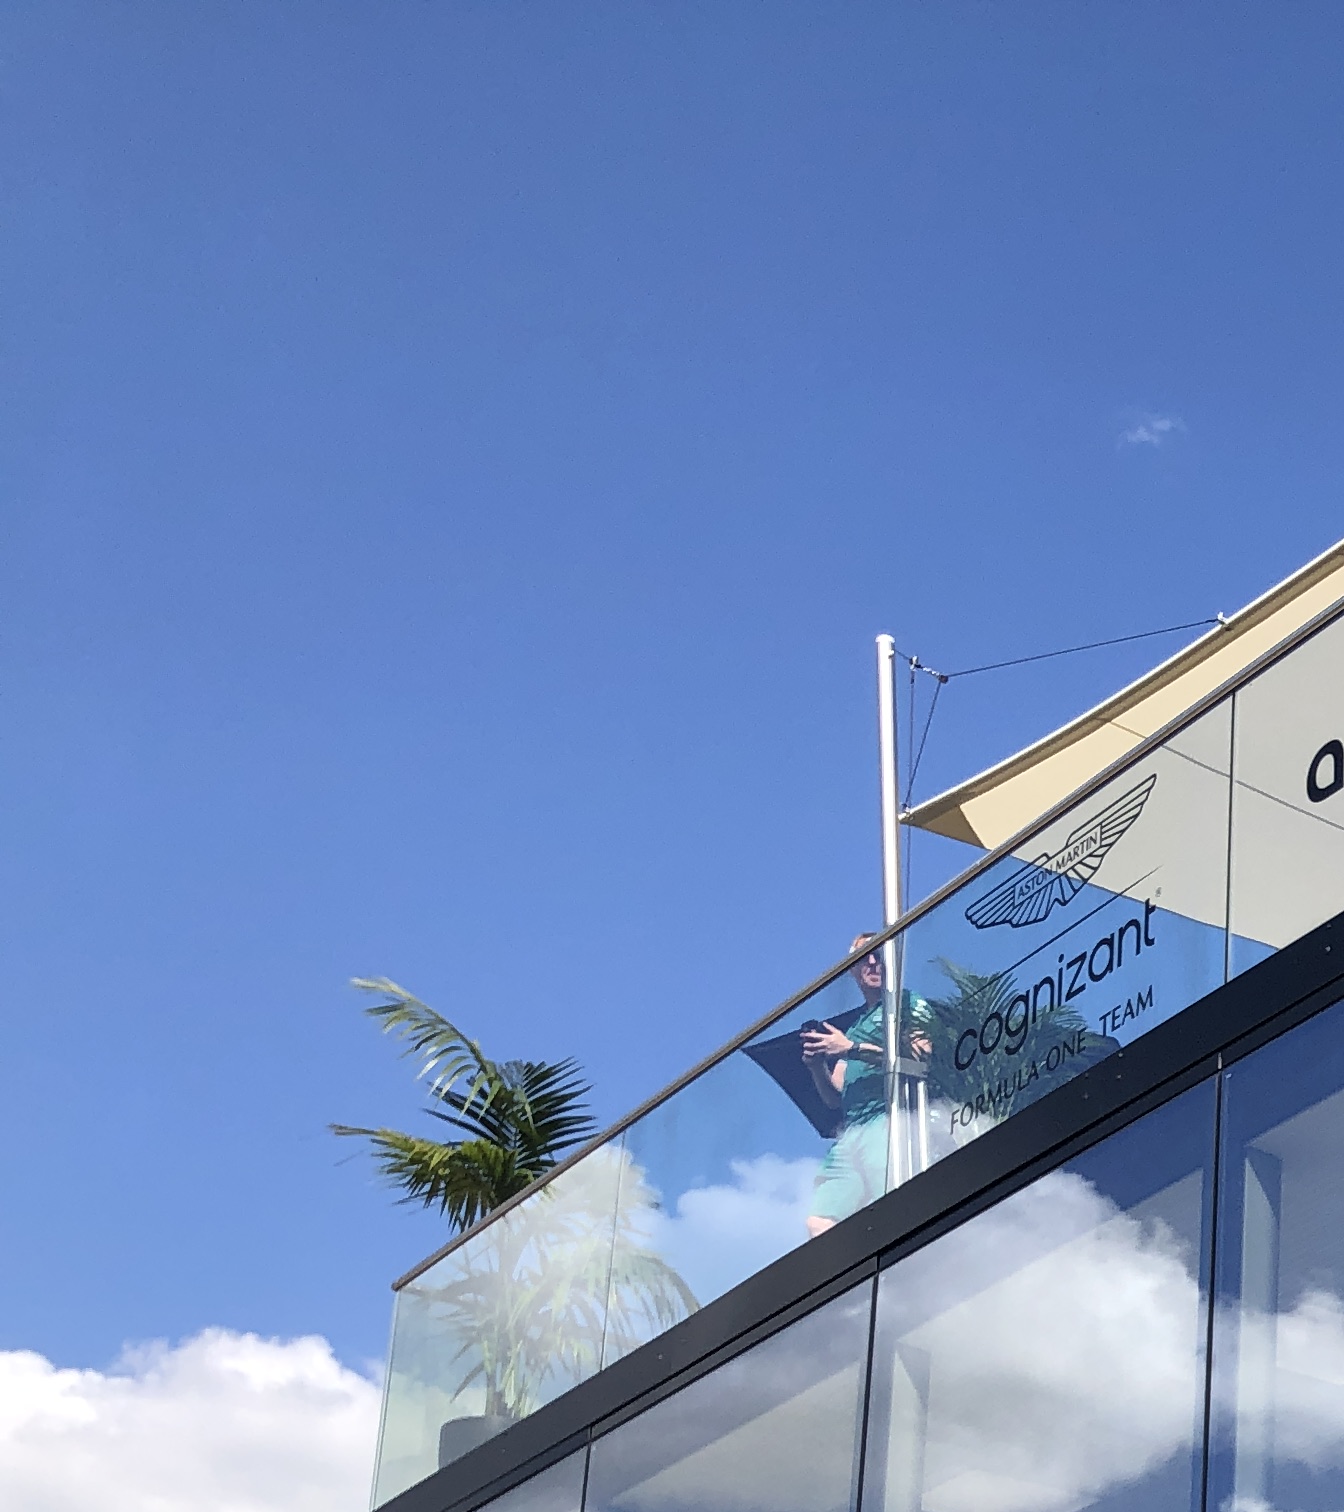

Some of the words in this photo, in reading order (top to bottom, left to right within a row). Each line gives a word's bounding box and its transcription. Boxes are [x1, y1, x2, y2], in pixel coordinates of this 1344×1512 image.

[1017, 864, 1053, 899] ASTON
[1054, 831, 1098, 873] MARTIN
[950, 1060, 1039, 1135] FORMULA
[1046, 1027, 1087, 1071] ONE
[1098, 984, 1154, 1038] TEAM
[954, 898, 1156, 1071] cognizant
